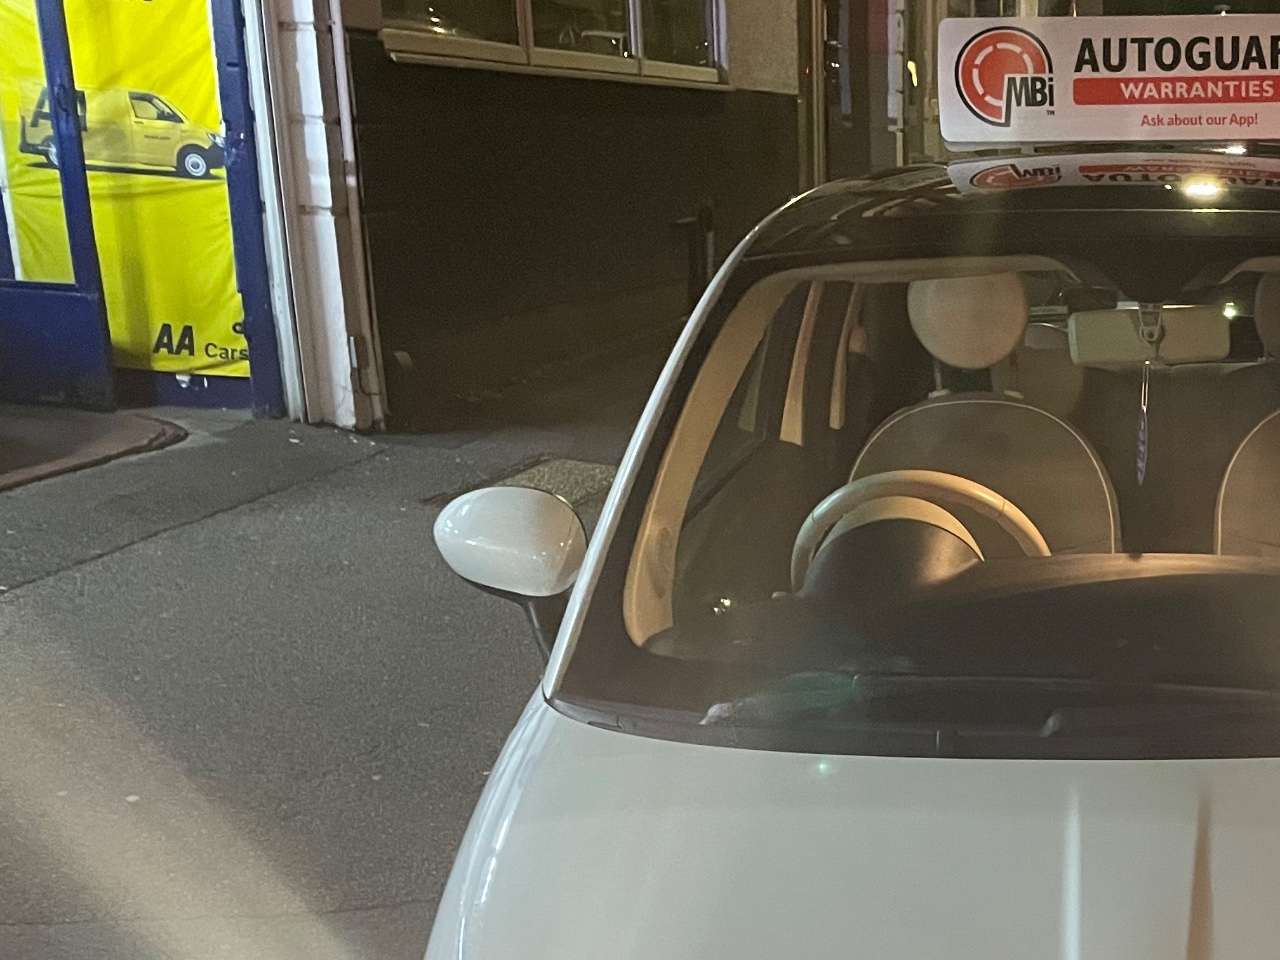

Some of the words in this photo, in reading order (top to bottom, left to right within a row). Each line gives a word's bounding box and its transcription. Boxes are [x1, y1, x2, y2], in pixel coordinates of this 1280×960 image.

[1120, 80, 1274, 99] WARRANTIES
[1141, 114, 1164, 127] Ask
[1167, 113, 1203, 126] about
[1206, 115, 1228, 126] our
[1229, 112, 1259, 127] App!
[153, 323, 195, 357] AA
[204, 342, 248, 360] Cars
